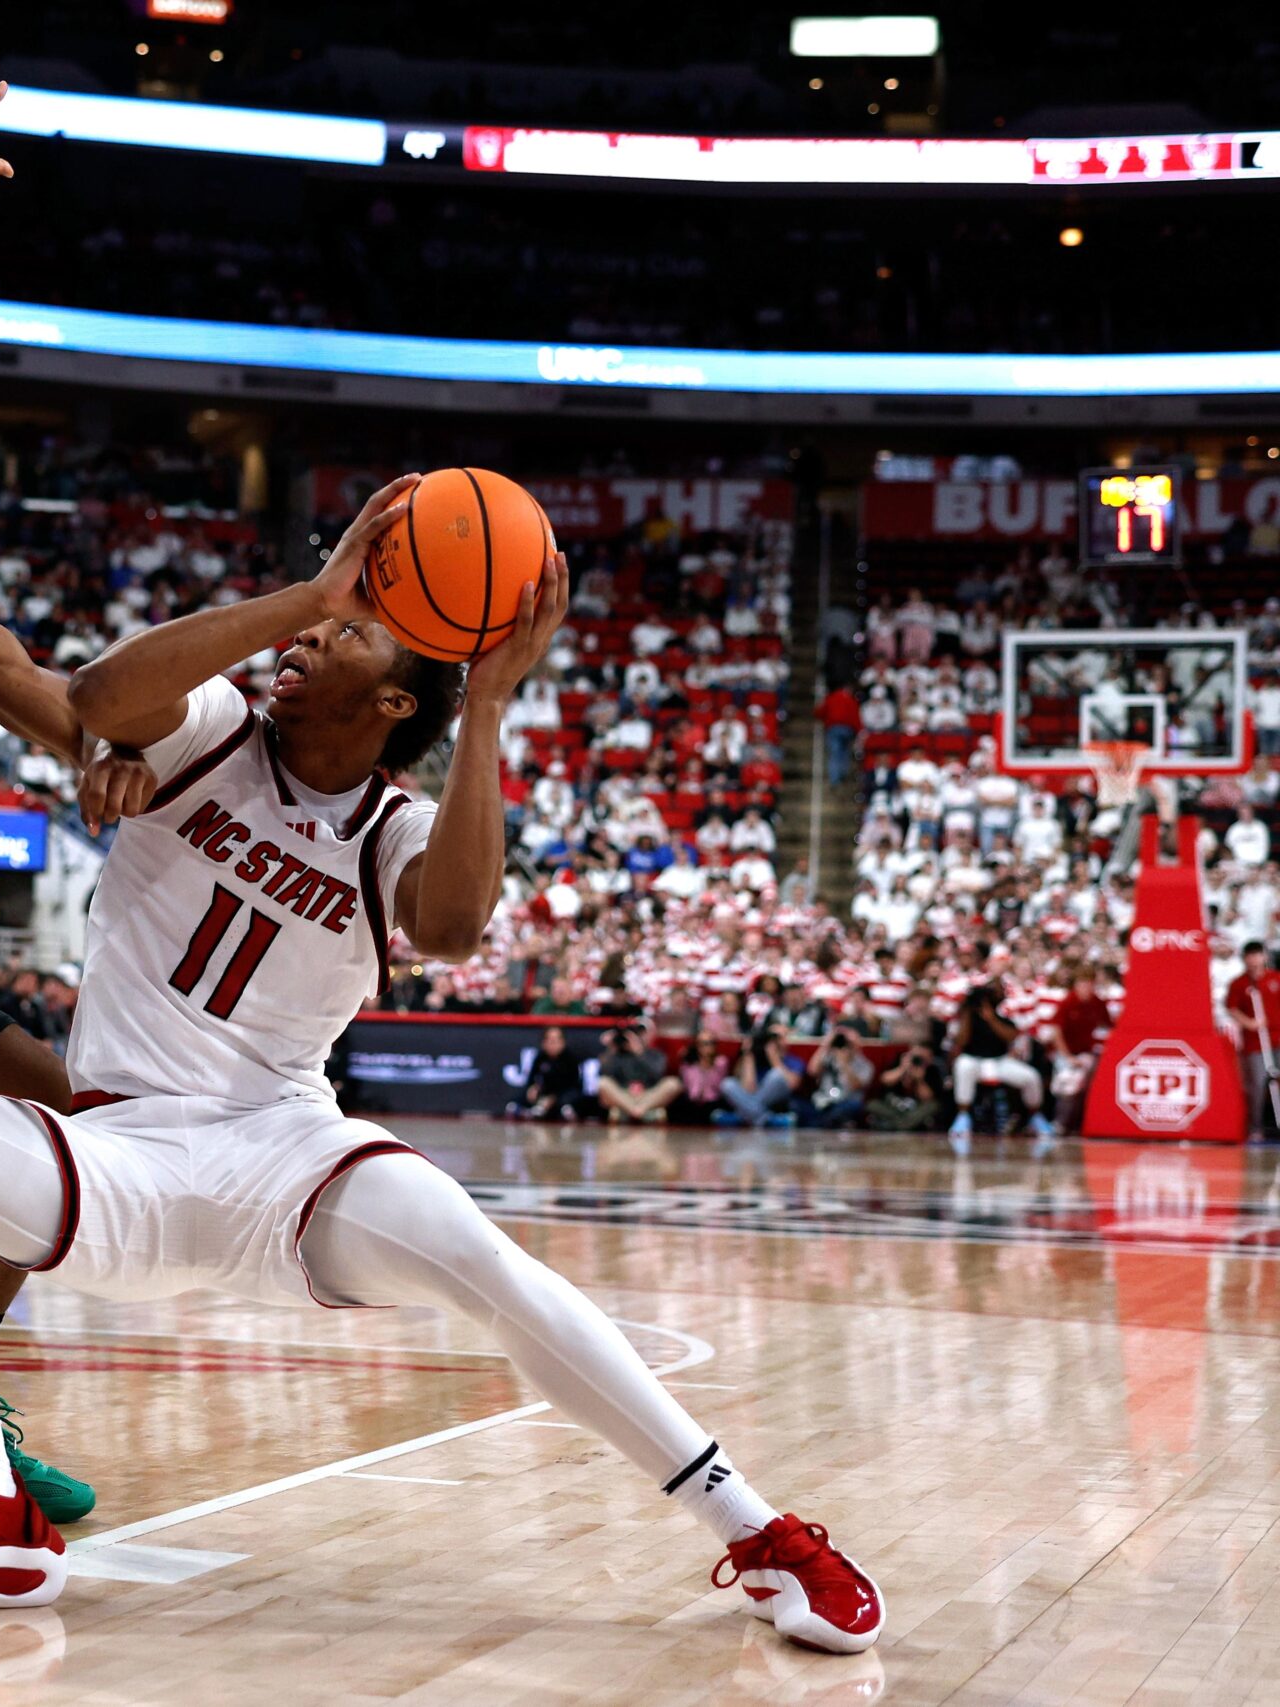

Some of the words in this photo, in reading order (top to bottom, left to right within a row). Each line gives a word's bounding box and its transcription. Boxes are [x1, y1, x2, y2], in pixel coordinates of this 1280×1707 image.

[1116, 505, 1163, 553] 17
[176, 799, 252, 863] NC
[234, 840, 358, 935] STATE
[167, 881, 283, 1021] 11
[1128, 1073, 1197, 1097] CPI
